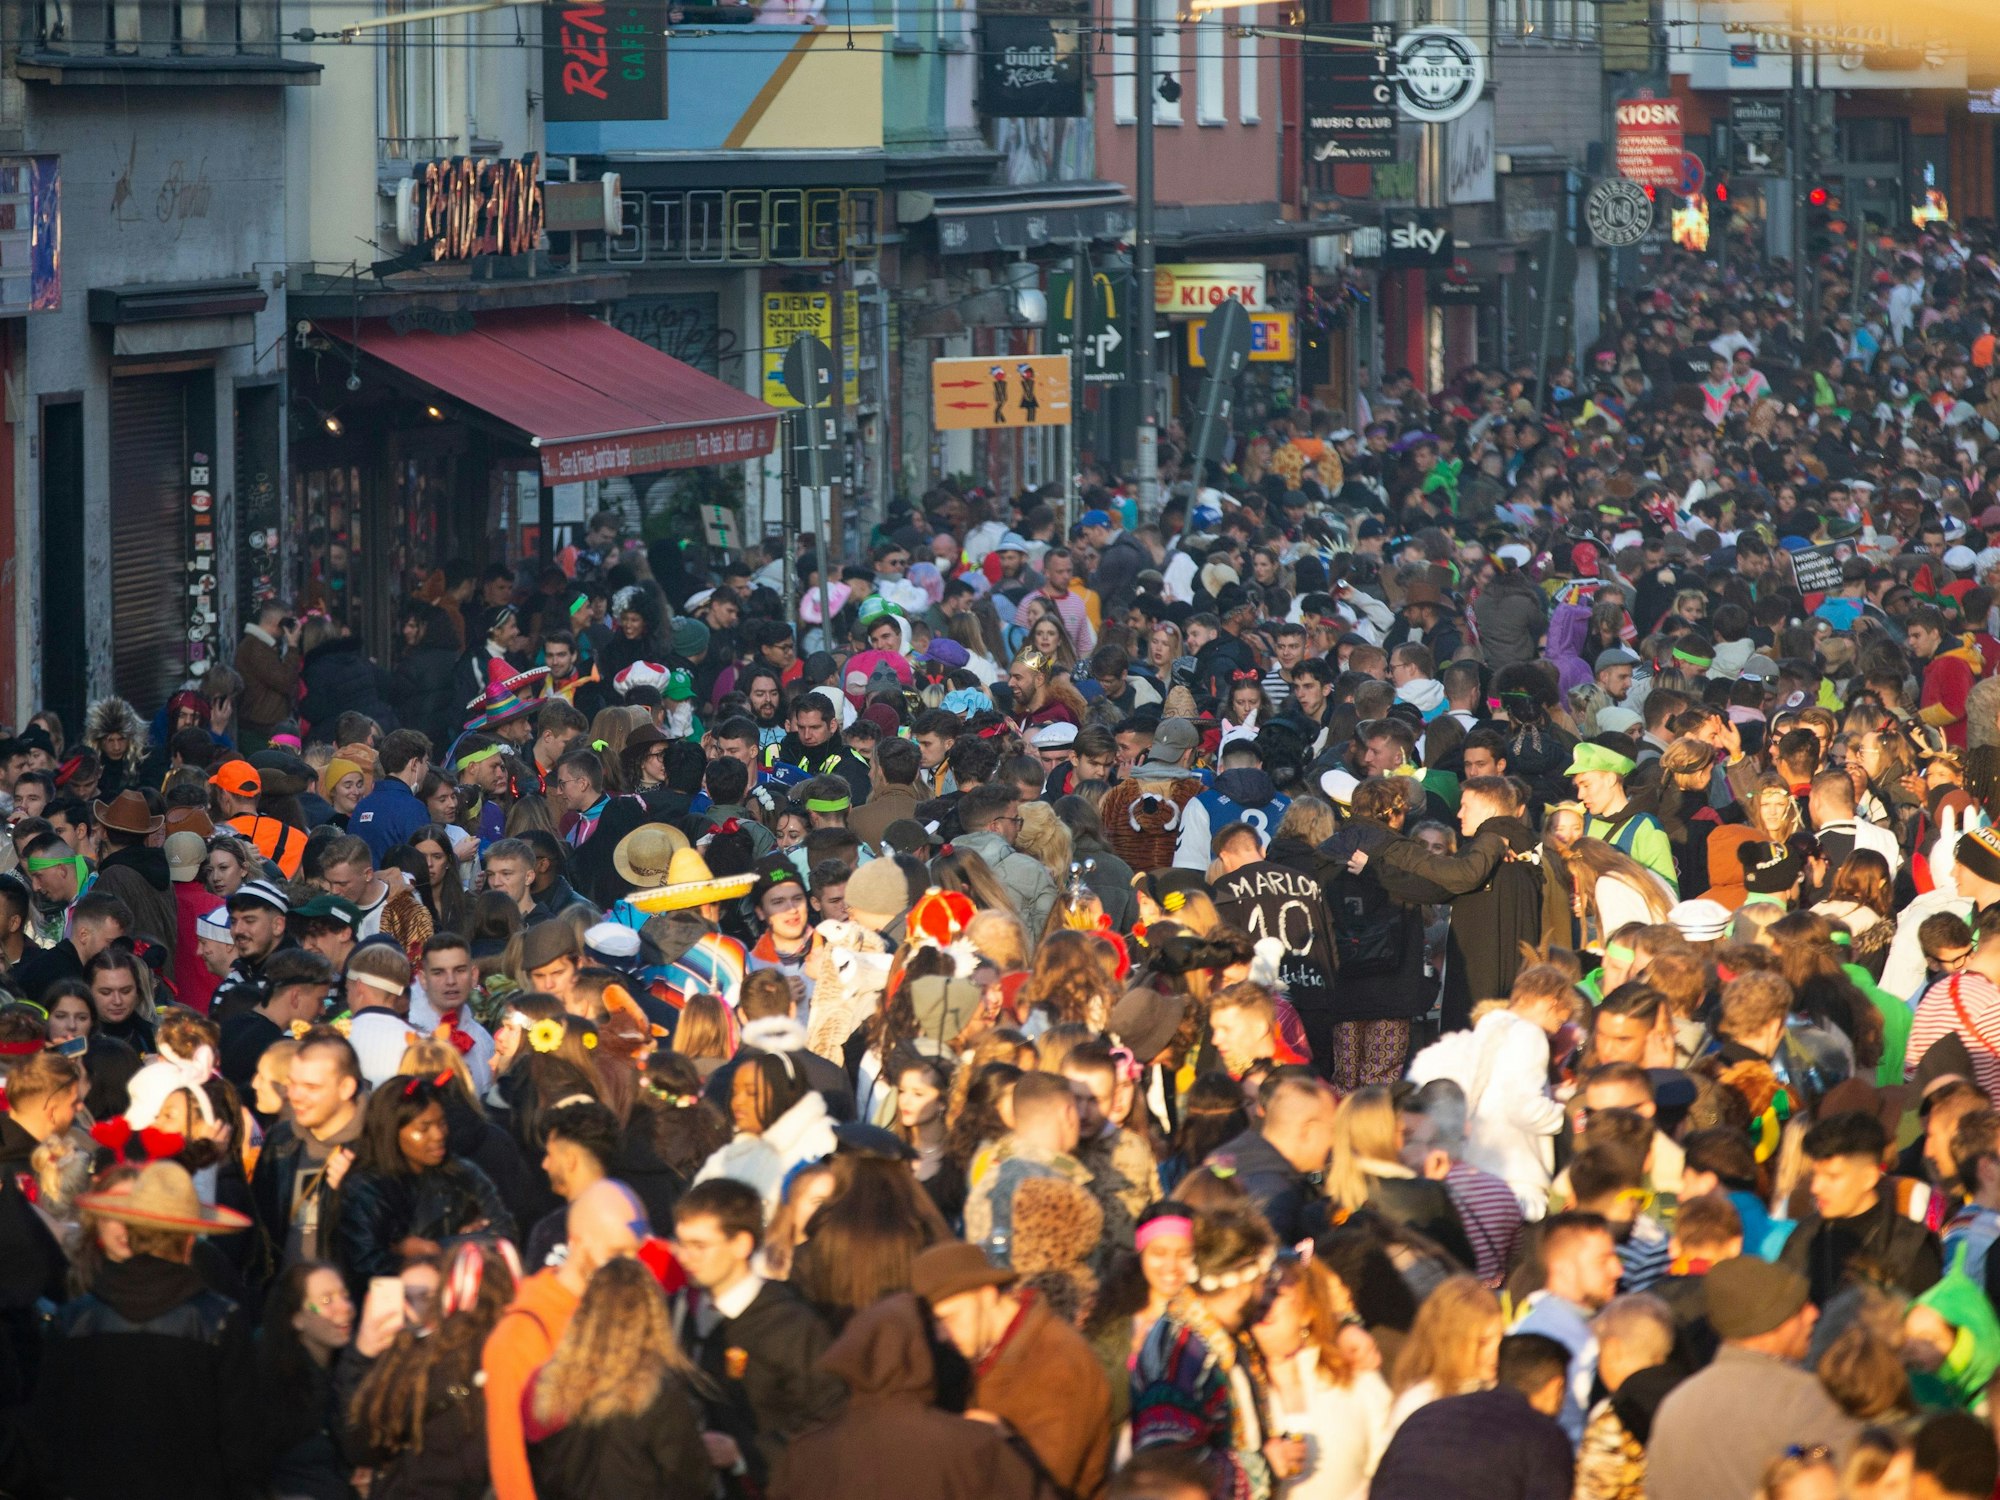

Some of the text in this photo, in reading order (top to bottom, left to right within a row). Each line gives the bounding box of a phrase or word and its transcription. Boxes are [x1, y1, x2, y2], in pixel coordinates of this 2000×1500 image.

[1311, 117, 1393, 129] MUSIC CLUB
[1616, 104, 1680, 125] KIOSK
[1391, 221, 1446, 255] sky
[1248, 899, 1315, 957] 10
